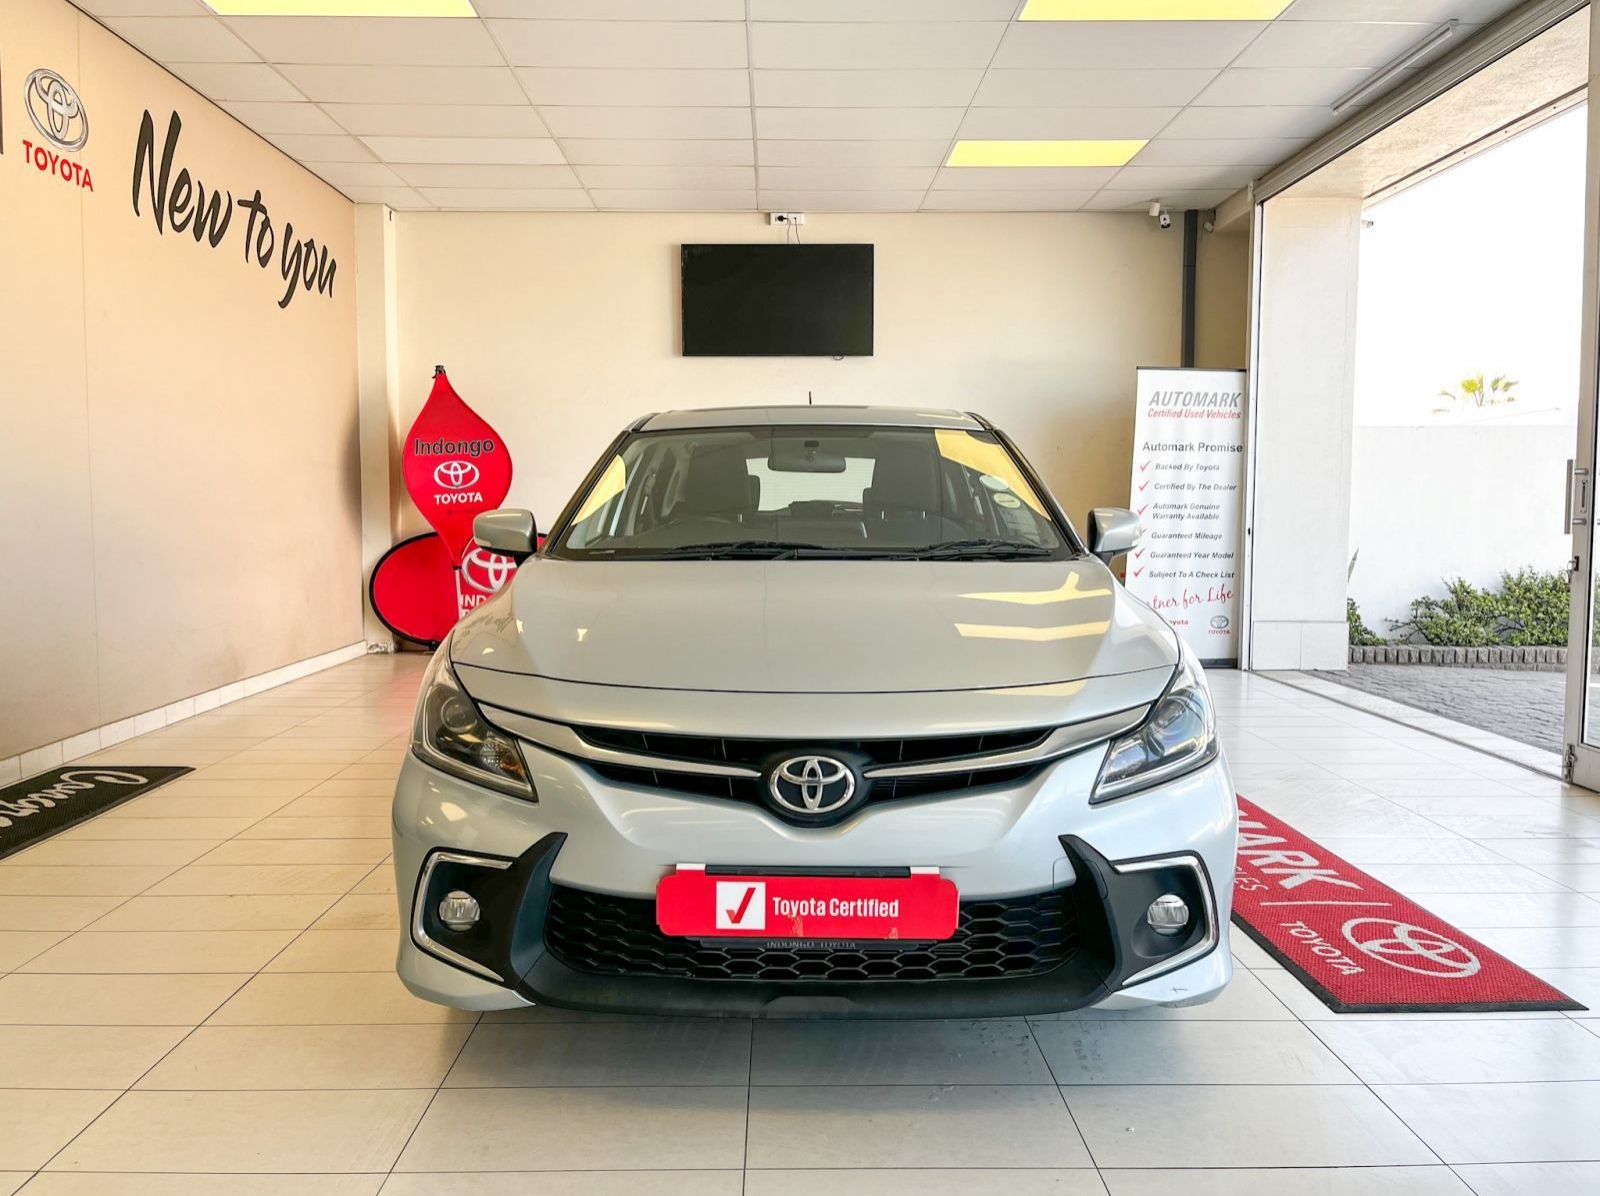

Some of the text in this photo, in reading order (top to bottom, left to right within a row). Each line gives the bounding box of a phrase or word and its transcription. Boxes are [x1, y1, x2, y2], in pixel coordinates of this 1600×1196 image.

[22, 139, 94, 192] TOYOTA
[132, 109, 337, 309] New to you
[1149, 391, 1241, 408] AUTOMARK
[1147, 408, 1241, 419] Certified Used Vehicles
[414, 438, 495, 457] Indongo
[1142, 441, 1243, 453] Automark Promise
[1155, 463, 1220, 472] Backed By Toyota
[1154, 482, 1238, 491] Certified By The Dealer
[434, 492, 483, 505] TOYOTA
[1194, 532, 1222, 540] Mileage
[1149, 571, 1176, 579] Subject
[1147, 583, 1234, 609] tner for Life
[1170, 619, 1189, 627] yota
[772, 897, 899, 918] Toyota Certified
[766, 941, 857, 949] INDONGO TOYOTA
[1280, 920, 1365, 976] TOYOTA
